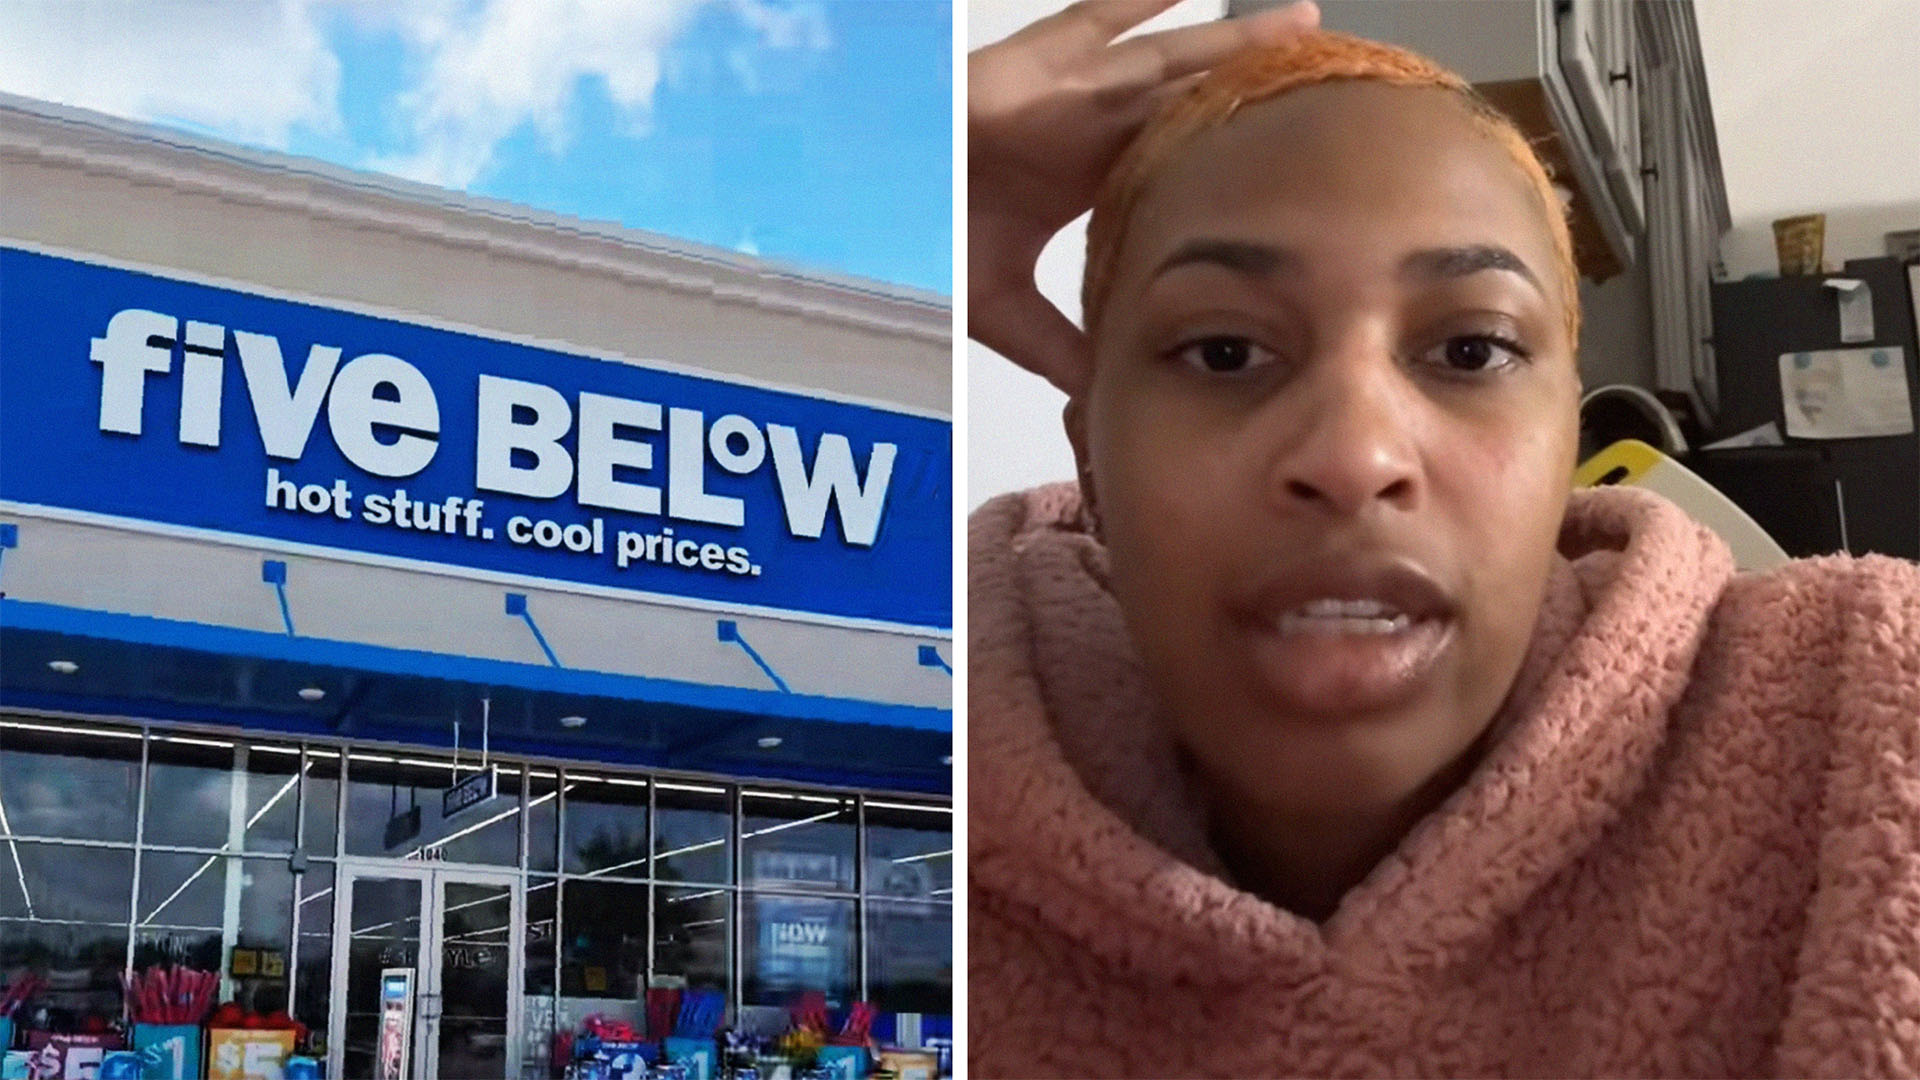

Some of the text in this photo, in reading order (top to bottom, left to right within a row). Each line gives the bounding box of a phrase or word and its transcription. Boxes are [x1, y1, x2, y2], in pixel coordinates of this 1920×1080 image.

[90, 309, 898, 546] five BELOW
[265, 468, 762, 576] hot stuff. cool prices.
